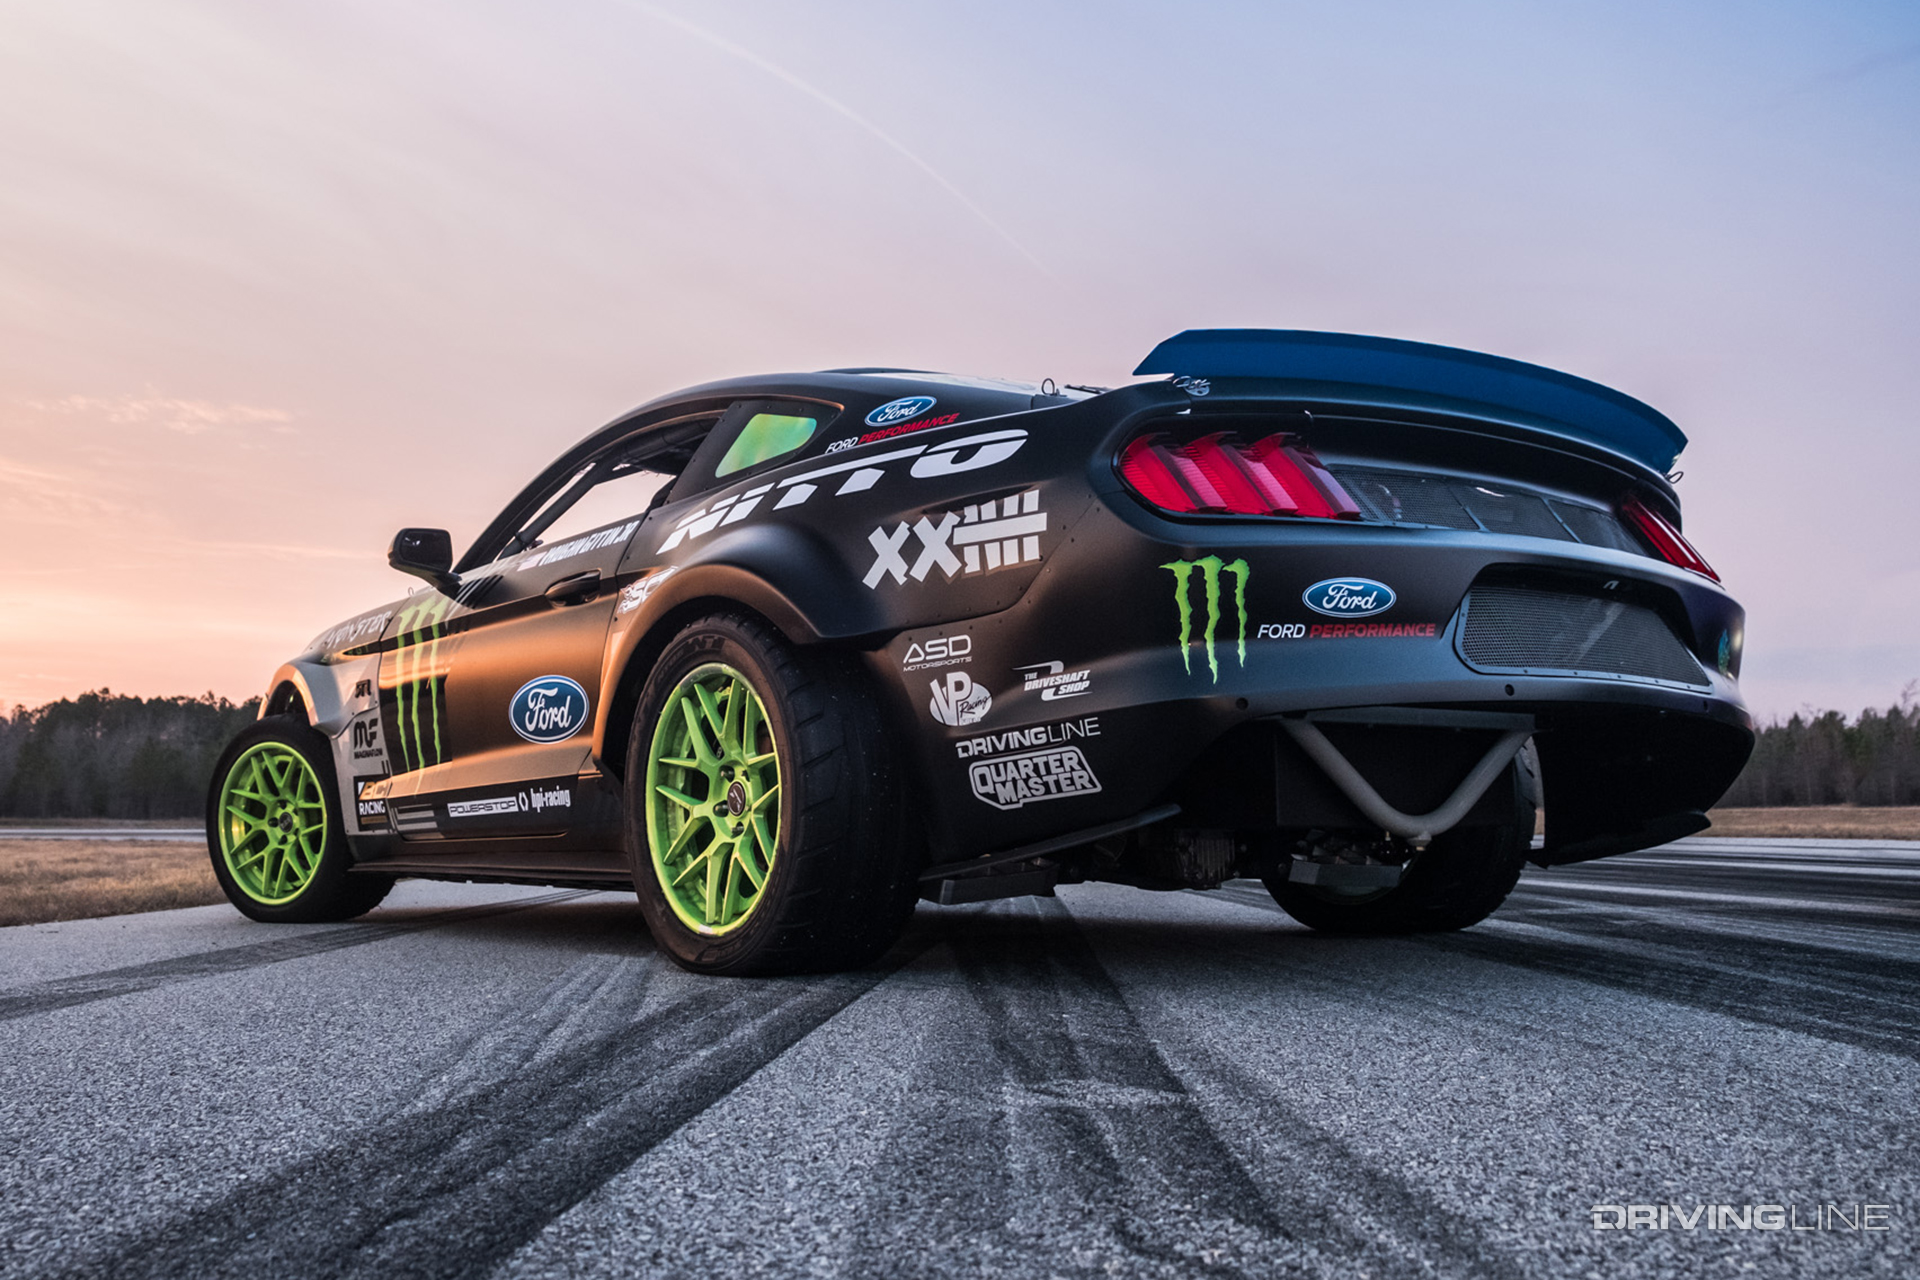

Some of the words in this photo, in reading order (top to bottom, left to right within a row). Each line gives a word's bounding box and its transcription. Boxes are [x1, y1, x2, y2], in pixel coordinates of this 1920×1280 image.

[877, 399, 922, 422] Ford
[825, 437, 859, 454] FORD
[858, 412, 960, 444] PERFORMANCE
[655, 429, 1029, 555] NITTO
[1322, 583, 1378, 610] Ford
[1257, 624, 1306, 638] FORD
[1309, 623, 1436, 638] PERFORMANCE
[903, 634, 971, 663] ASD
[903, 656, 972, 672] MOTORSPORTS
[1024, 669, 1090, 691] DRIVESHAFT
[1058, 680, 1090, 695] SHOP
[525, 687, 571, 731] Ford
[930, 671, 971, 726] VP
[959, 696, 991, 718] Racing
[973, 752, 1082, 795] QUARTER
[995, 770, 1093, 804] MASTER
[358, 800, 386, 816] RACING
